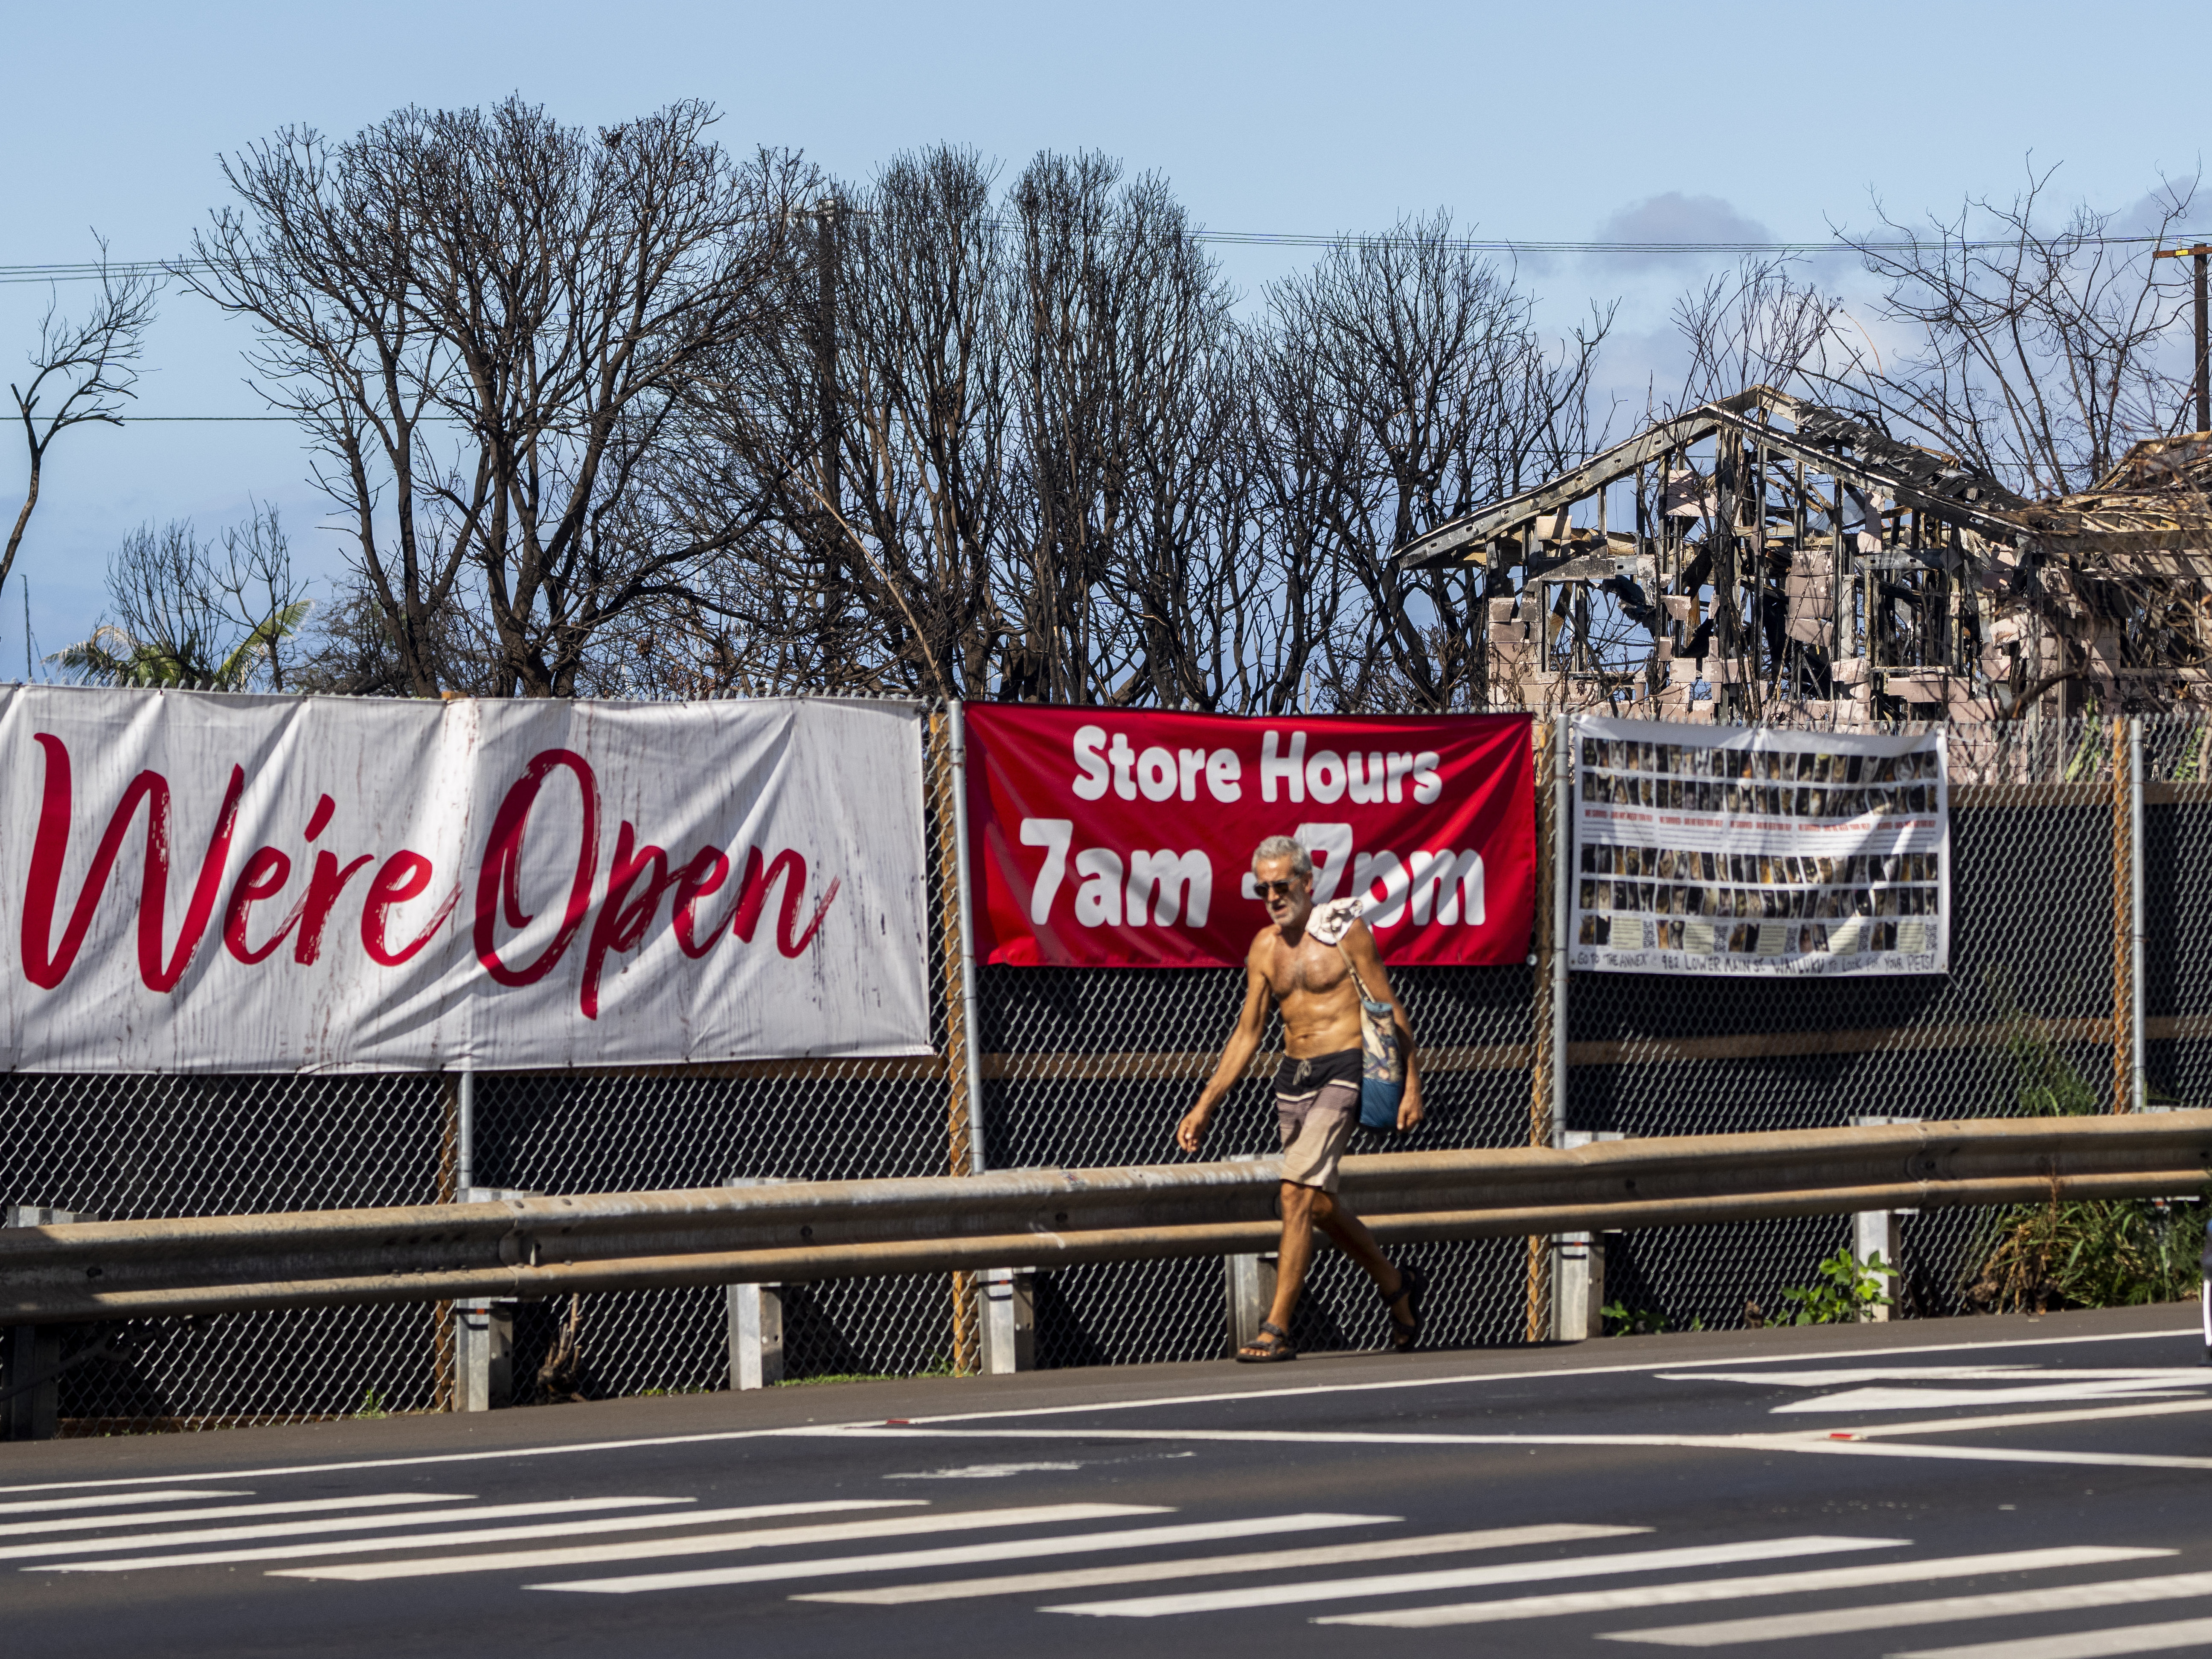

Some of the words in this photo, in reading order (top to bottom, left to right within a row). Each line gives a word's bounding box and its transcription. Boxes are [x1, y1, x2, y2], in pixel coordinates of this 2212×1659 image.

[1072, 725, 1242, 803] Store
[1260, 730, 1443, 805] Hours
[21, 733, 463, 993] We're
[474, 749, 840, 1020] Open
[1019, 817, 1213, 928] 7am
[1293, 822, 1486, 934] 7pm
[1684, 954, 1721, 972] LOWER
[1724, 957, 1751, 972] MAIN
[1770, 957, 1825, 974] WAILUKU
[1907, 954, 1935, 972] PETS!
